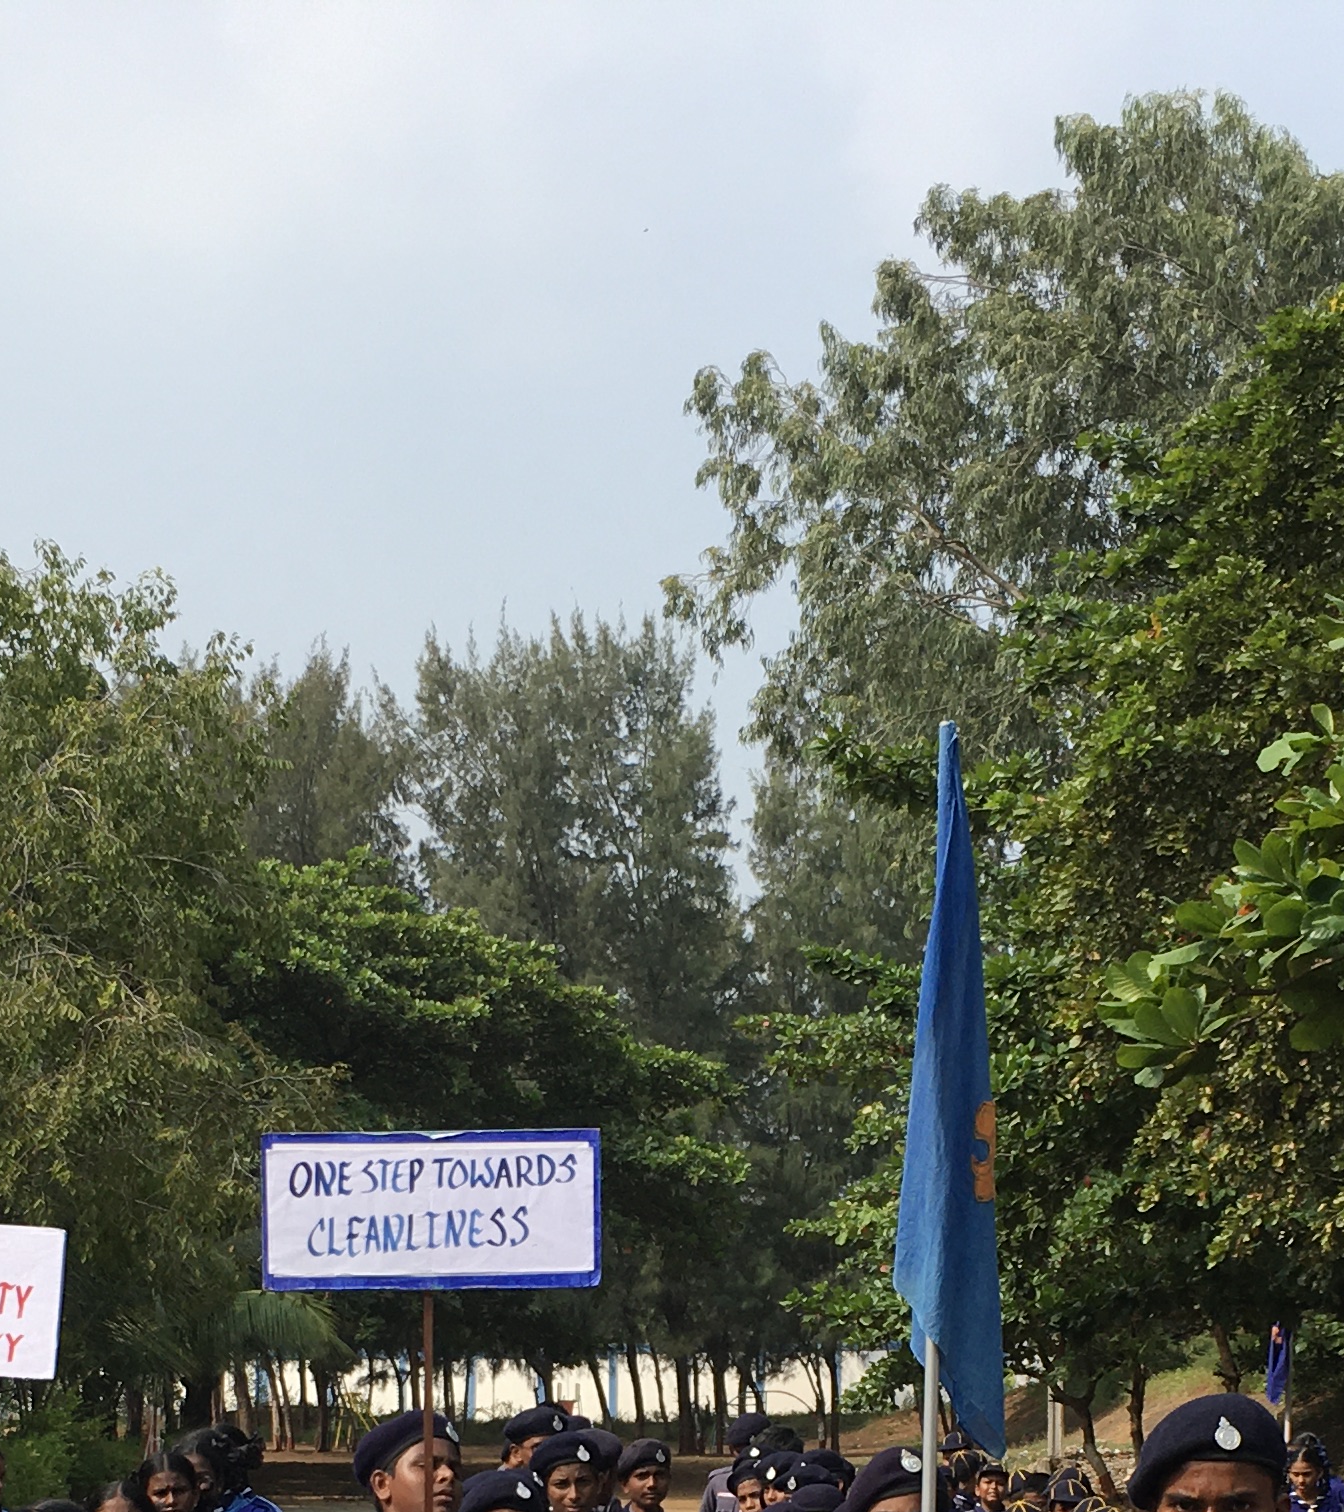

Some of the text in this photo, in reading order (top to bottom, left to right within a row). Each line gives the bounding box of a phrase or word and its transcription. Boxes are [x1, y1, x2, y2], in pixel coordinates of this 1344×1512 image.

[289, 1153, 579, 1198] ONE STEP TOWARDS
[307, 1205, 530, 1258] CLEANLINESS
